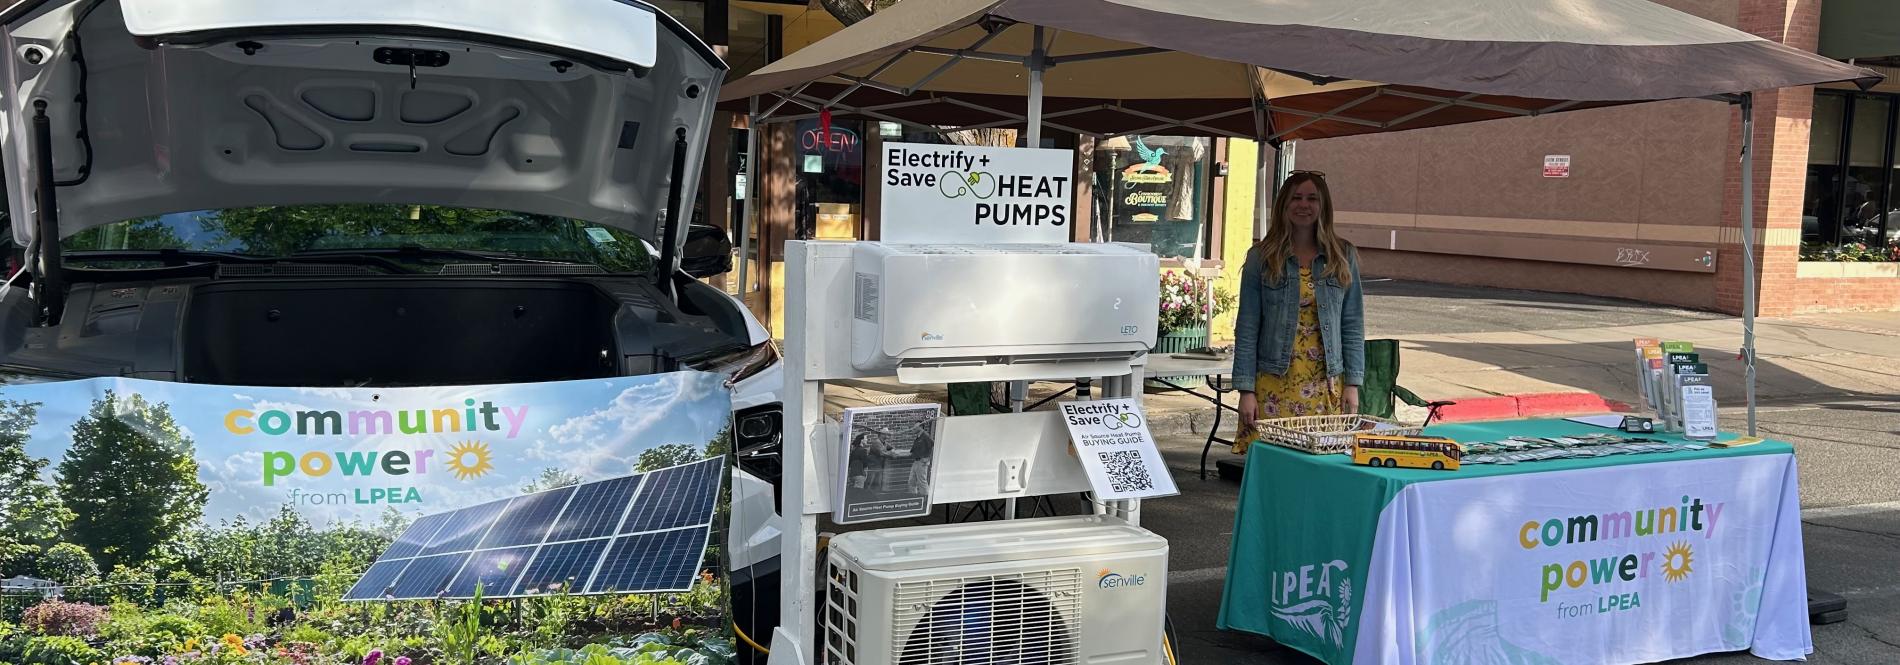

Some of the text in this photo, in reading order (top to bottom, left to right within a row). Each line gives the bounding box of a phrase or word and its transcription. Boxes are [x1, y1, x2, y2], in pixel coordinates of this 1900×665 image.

[888, 148, 990, 172] Electrify +
[887, 168, 936, 187] Save
[998, 175, 1068, 198] HEAT
[1125, 192, 1167, 205] BOUTIQUE
[975, 203, 1066, 226] PUMPS
[1113, 297, 1121, 310] 2
[1120, 325, 1138, 334] LETO
[224, 398, 529, 439] community
[1064, 402, 1130, 415] Electrify +
[1068, 415, 1101, 426] Save
[1083, 437, 1144, 446] BUYING GUIDE
[263, 449, 435, 487] power
[291, 487, 424, 506] from LPEA
[1519, 495, 1725, 549] community
[1103, 574, 1145, 588] senville
[1271, 561, 1336, 605] LPEA
[1540, 551, 1656, 603] power
[1557, 591, 1641, 620] from LPEA
